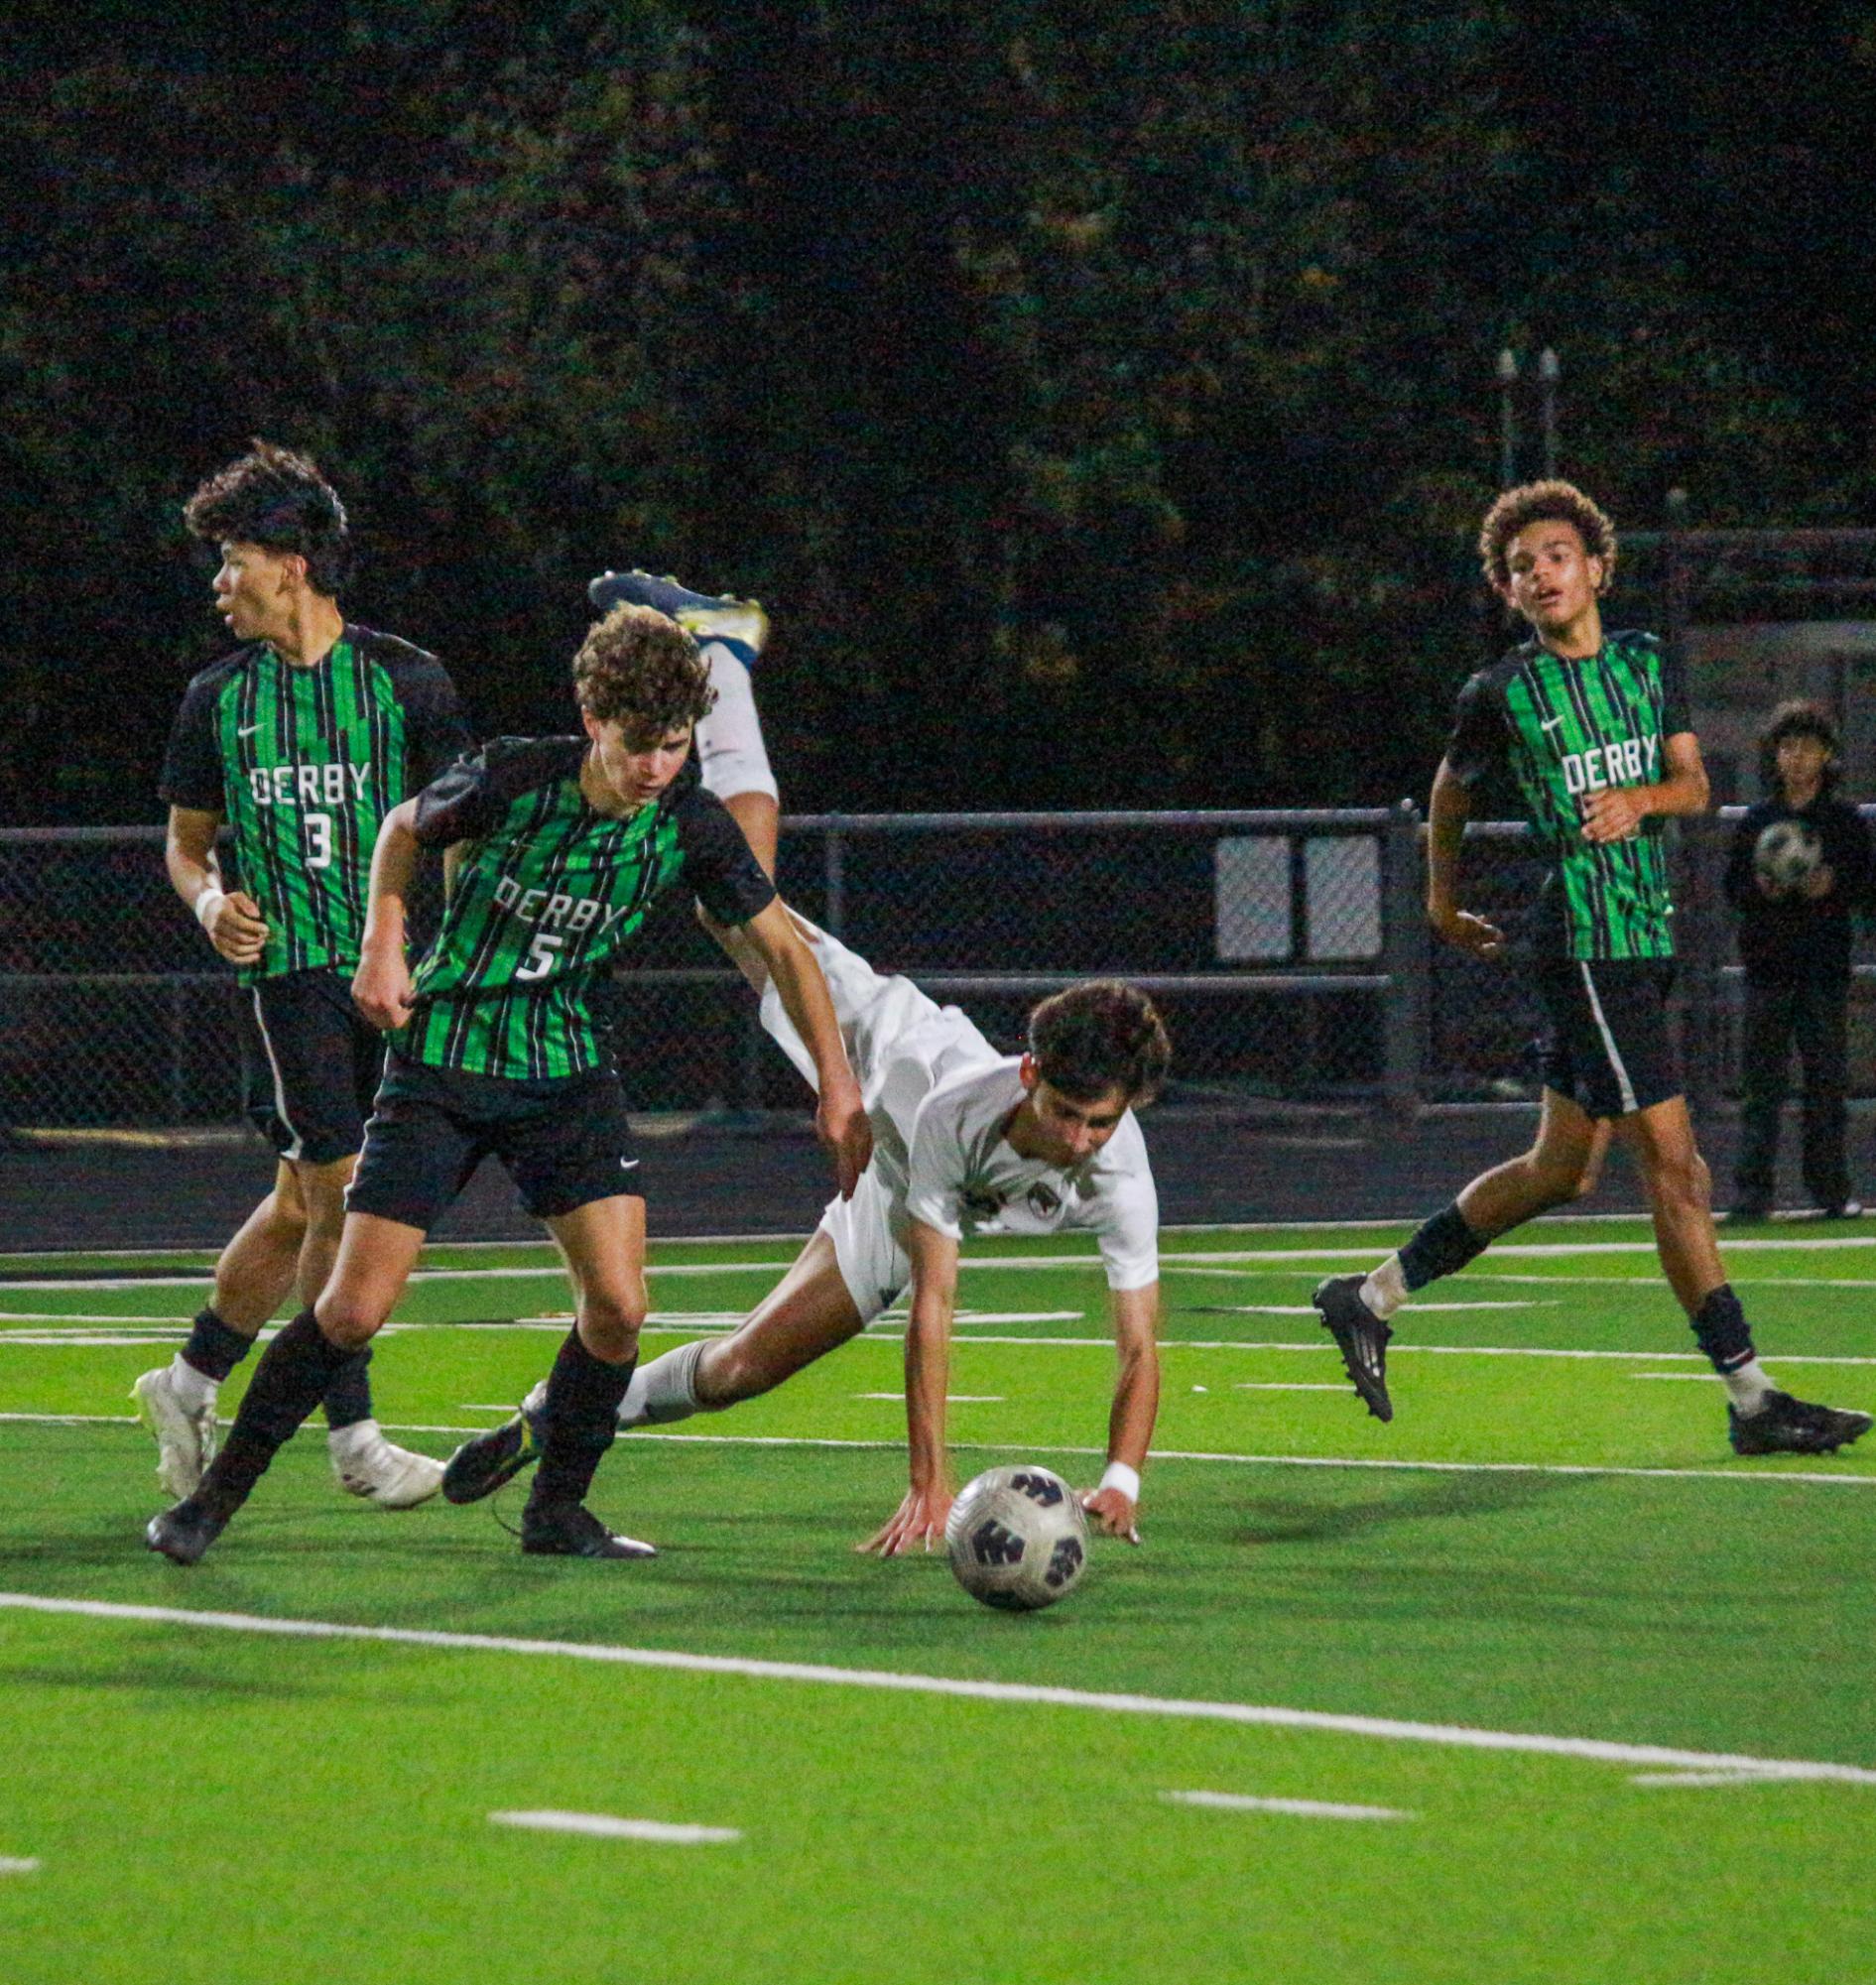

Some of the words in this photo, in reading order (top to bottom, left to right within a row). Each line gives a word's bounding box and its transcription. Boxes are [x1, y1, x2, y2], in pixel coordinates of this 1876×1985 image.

[250, 761, 370, 805] DERBY
[1562, 733, 1658, 794] DERBY
[304, 812, 331, 867] 3
[494, 875, 628, 934] DERBY
[515, 932, 563, 980] 5
